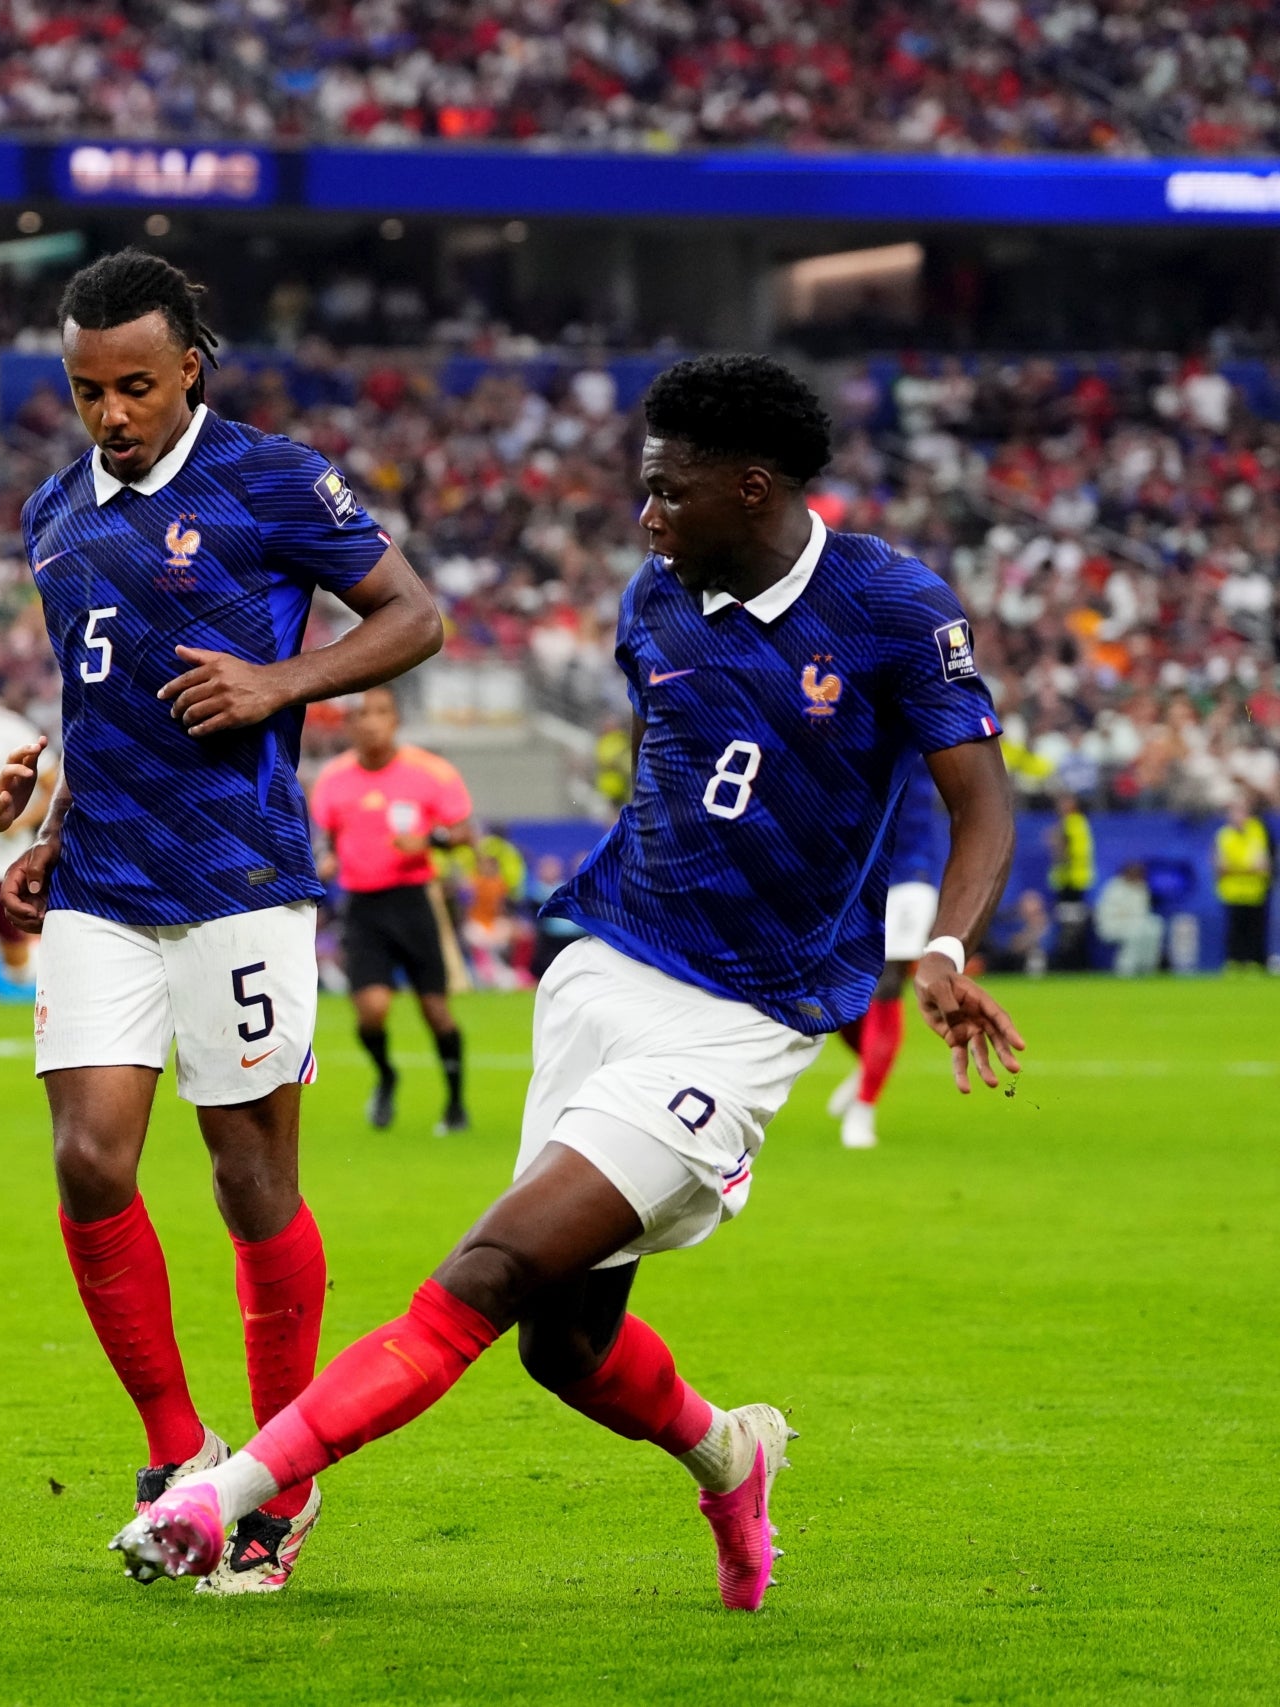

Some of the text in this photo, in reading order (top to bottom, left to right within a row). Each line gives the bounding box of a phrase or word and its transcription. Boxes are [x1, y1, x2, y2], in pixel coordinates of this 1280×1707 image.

[81, 606, 117, 683] 5
[702, 739, 762, 820] 8
[231, 961, 275, 1042] 5
